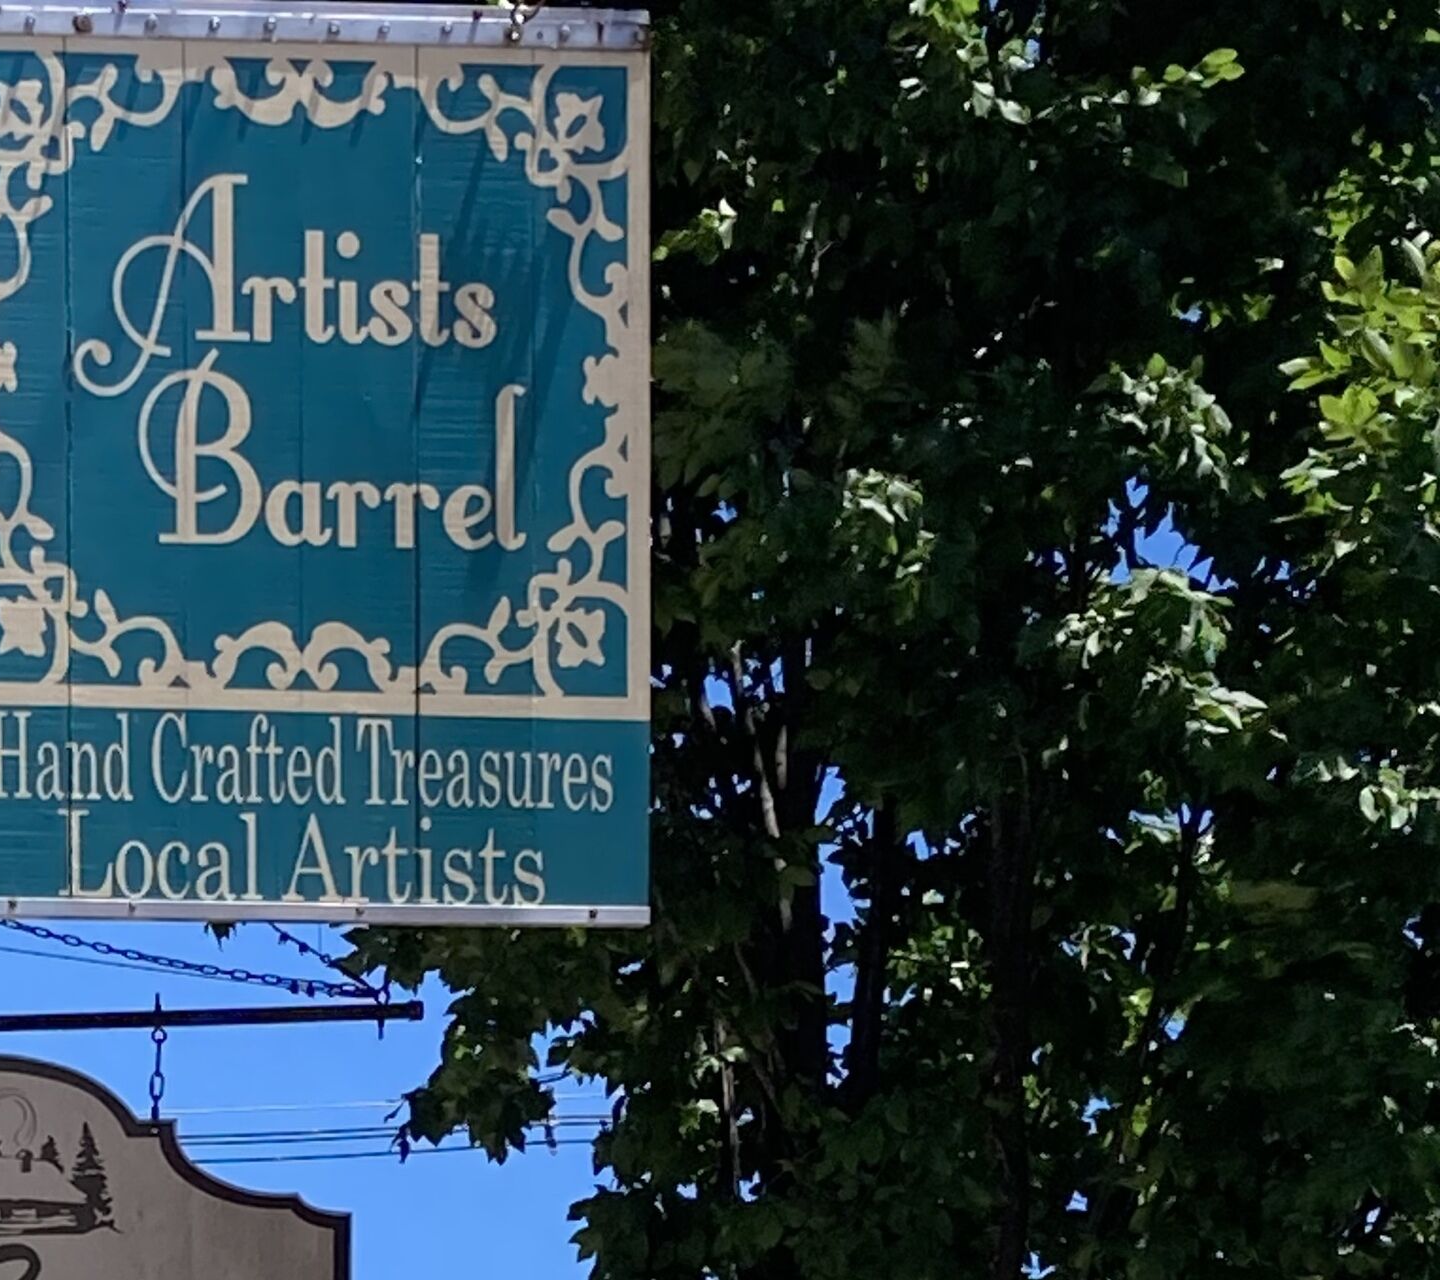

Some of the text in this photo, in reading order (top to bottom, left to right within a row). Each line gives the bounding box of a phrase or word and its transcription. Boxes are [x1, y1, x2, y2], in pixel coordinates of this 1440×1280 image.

[73, 173, 497, 397] Artists
[137, 348, 527, 550] Barrel
[151, 711, 343, 807] Crafted
[356, 716, 614, 813] Treasures
[58, 807, 546, 907] Local Artists
